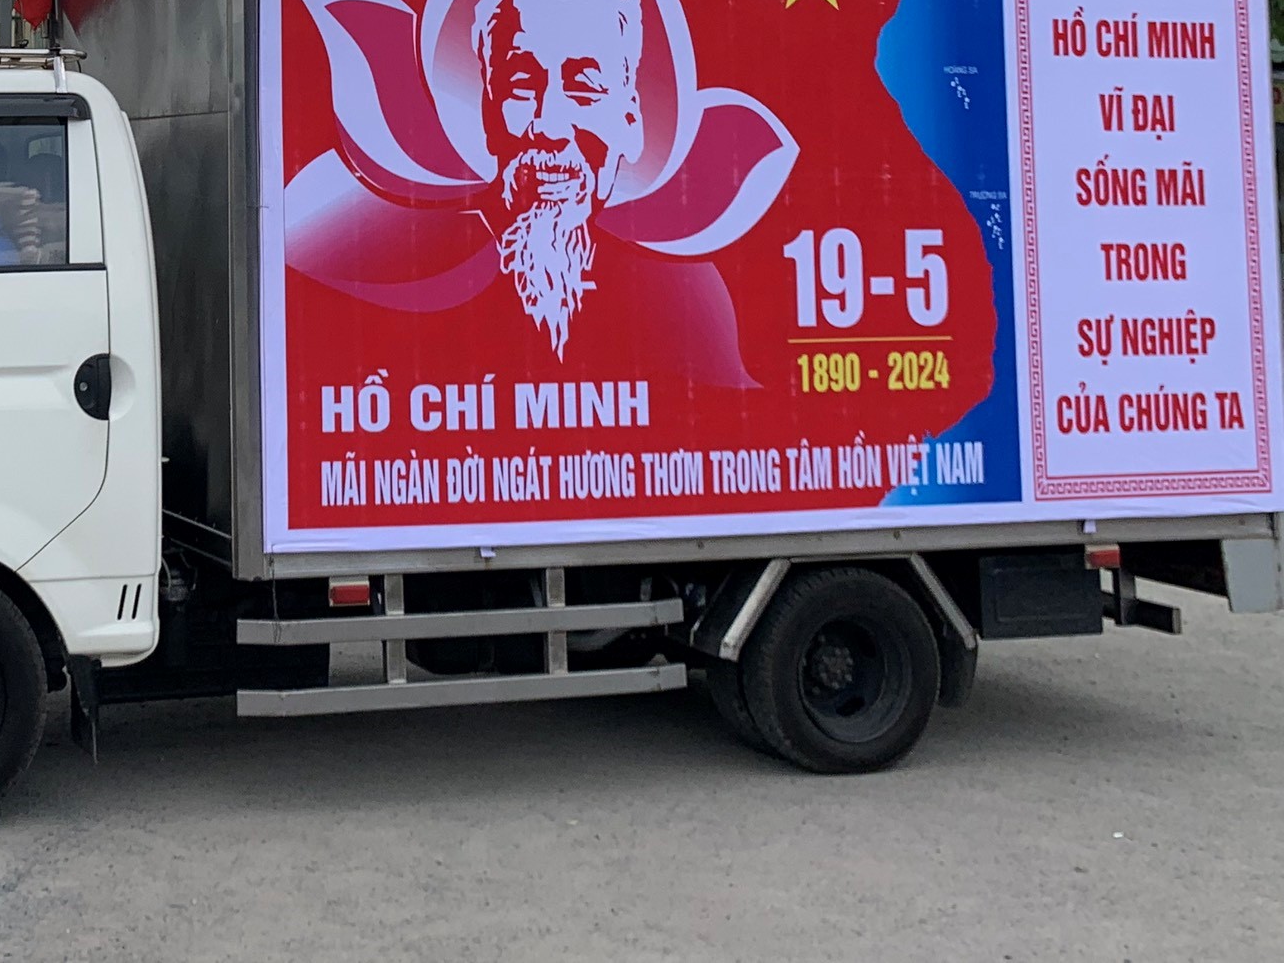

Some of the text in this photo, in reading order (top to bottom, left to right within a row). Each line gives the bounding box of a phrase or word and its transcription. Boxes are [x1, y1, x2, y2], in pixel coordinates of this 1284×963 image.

[1052, 6, 1216, 59] HỒ CHÍ MINH
[1099, 86, 1175, 140] VĨ ĐẠI
[1076, 154, 1206, 206] SỐNG MÃI
[783, 227, 950, 328] 19-5
[1100, 243, 1187, 281] TRONG
[1077, 309, 1216, 366] SỰ NGHIỆP
[797, 352, 861, 393] 1890
[887, 351, 951, 391] 2024
[321, 368, 650, 433] HỒ CHÍ MINH
[1056, 382, 1245, 434] CỦA CHÚNG TA
[321, 429, 984, 507] MÃI NGÀN ĐỜI NGÁT HƯƠNG THƠM TRONG TÂM HỒN VIỆT NAM
